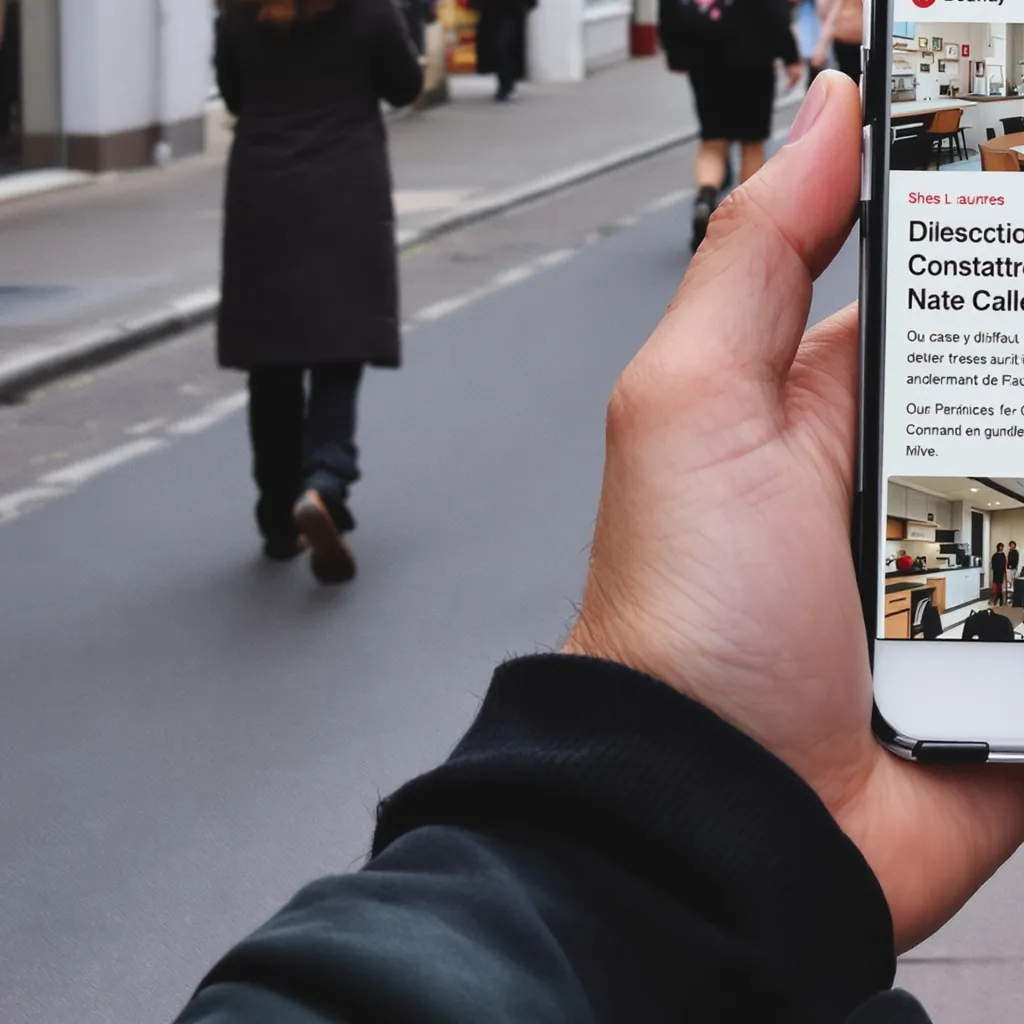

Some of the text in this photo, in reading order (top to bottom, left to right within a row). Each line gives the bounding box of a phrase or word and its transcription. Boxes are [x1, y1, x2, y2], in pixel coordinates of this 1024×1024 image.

[907, 287, 966, 311] Nate
[981, 373, 999, 386] de
[905, 423, 962, 437] Connand
[964, 427, 981, 437] en
